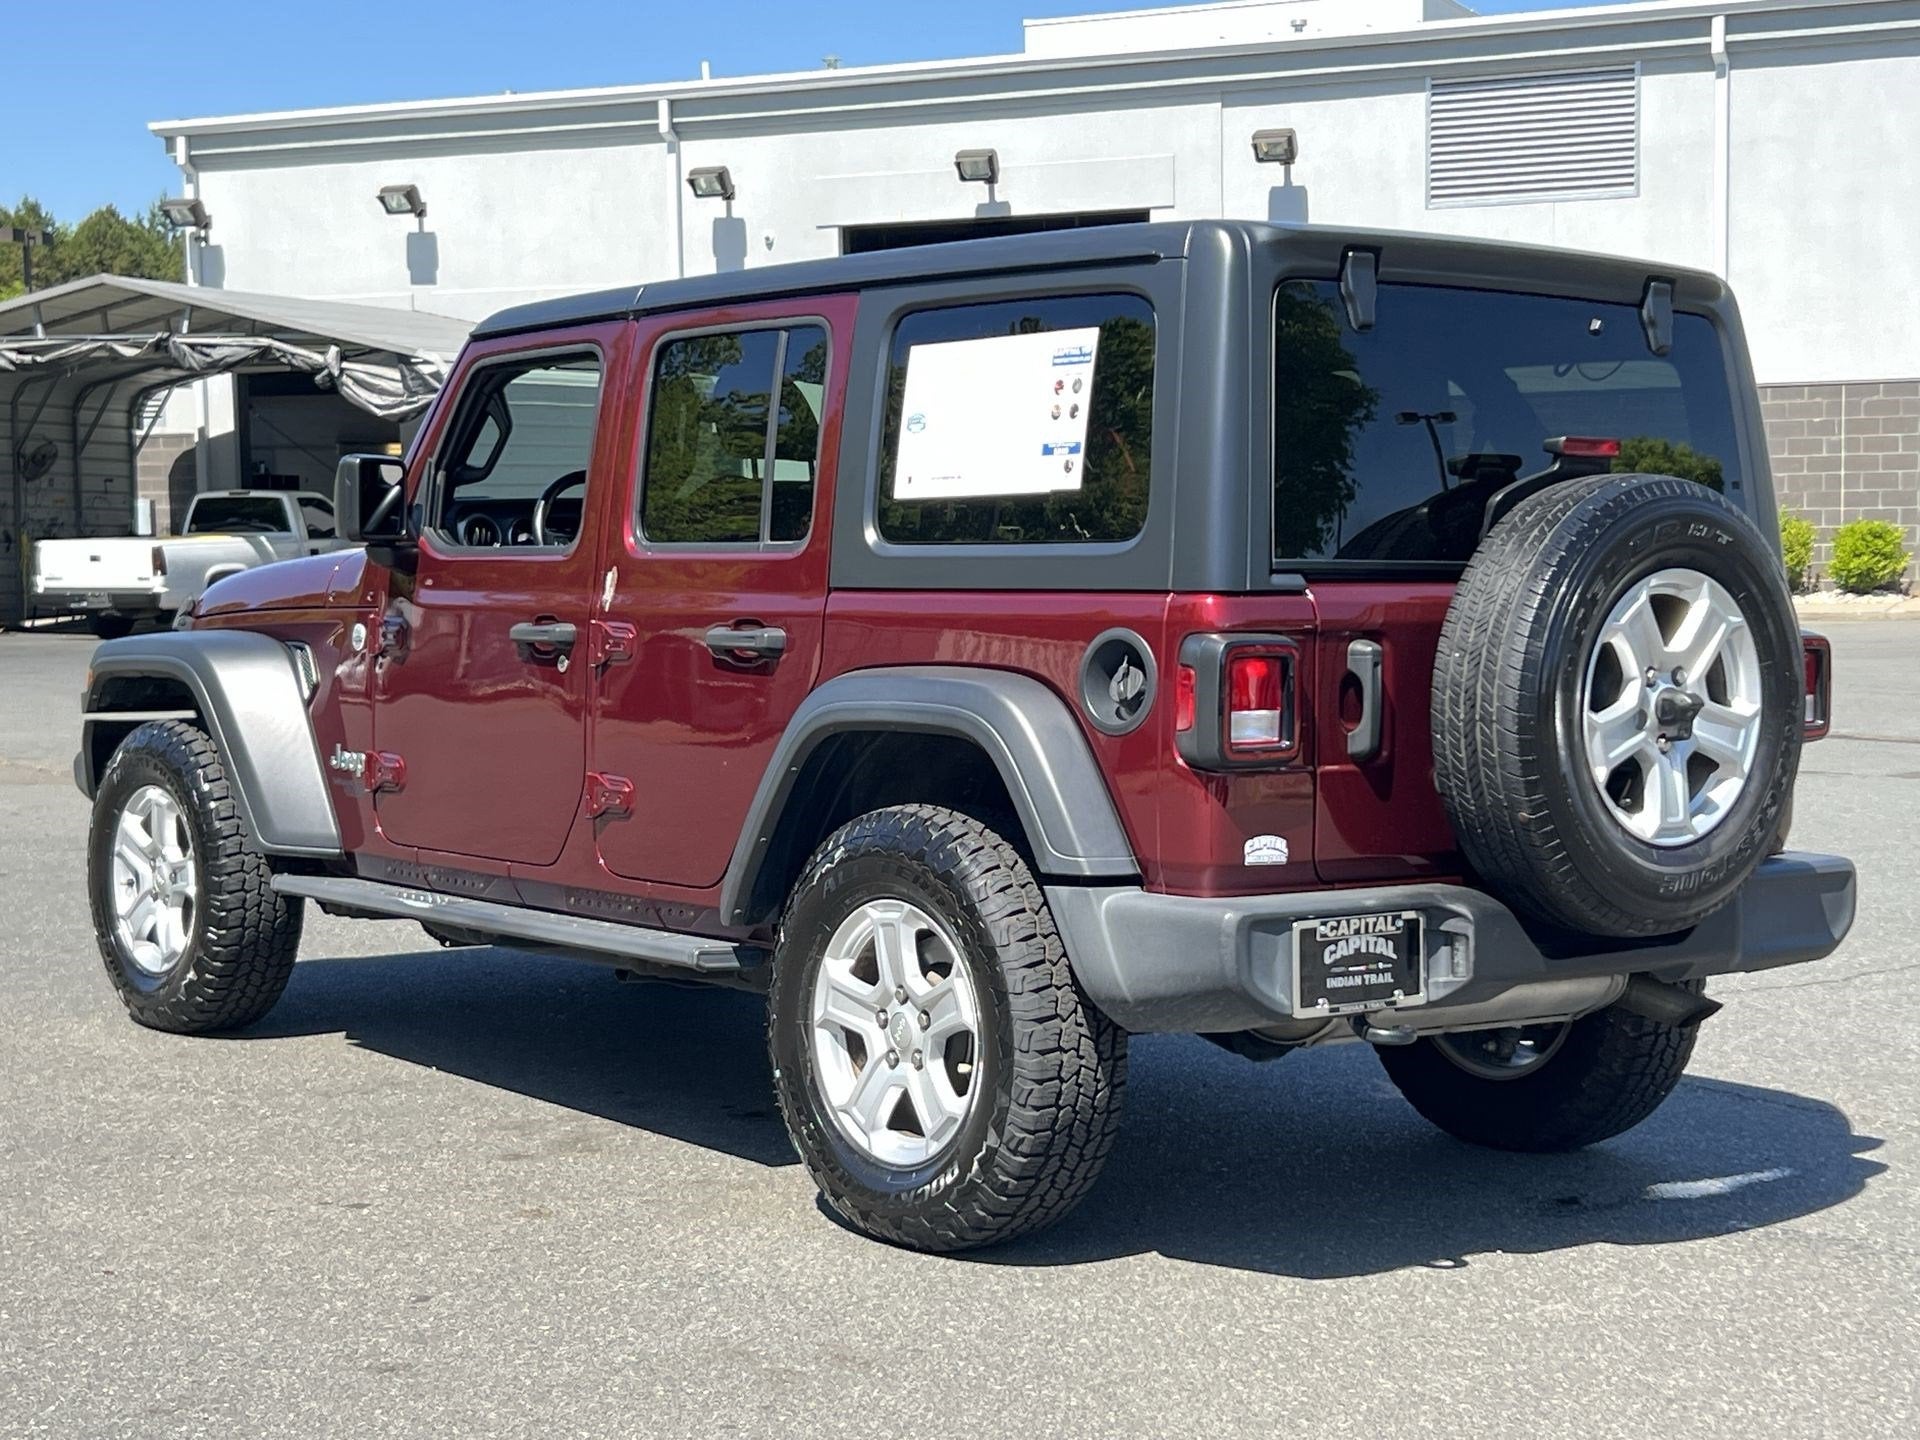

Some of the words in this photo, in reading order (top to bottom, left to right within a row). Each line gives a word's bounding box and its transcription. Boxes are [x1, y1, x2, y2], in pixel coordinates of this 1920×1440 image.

[1326, 915, 1397, 937] CAPITAL
[1323, 935, 1398, 965] CAPITAL
[1326, 975, 1362, 989] INDIAN
[1364, 972, 1394, 985] TRAIL
